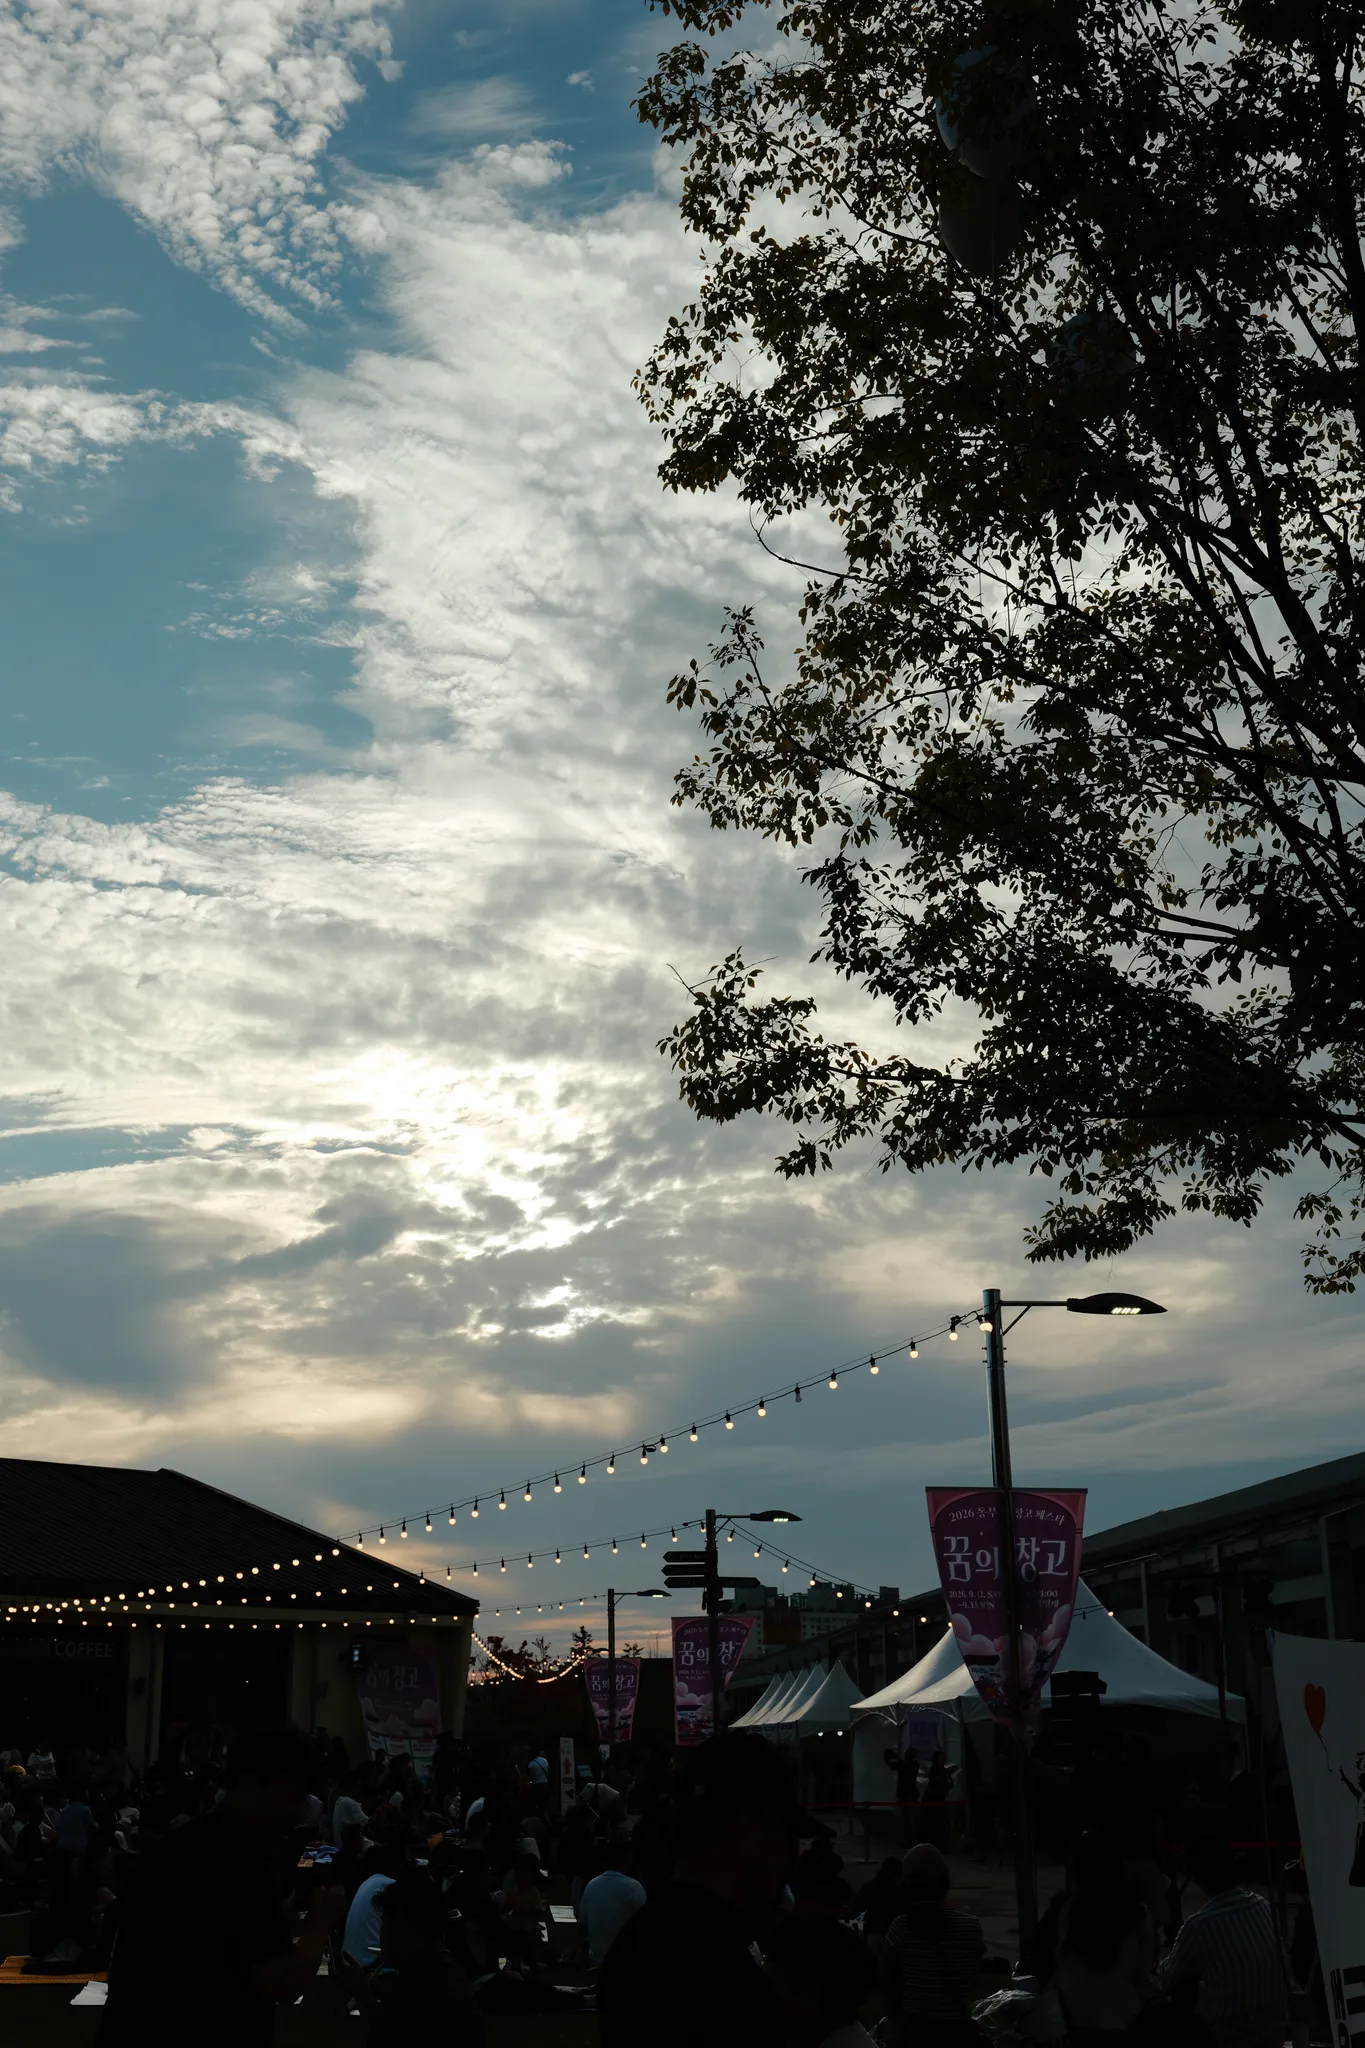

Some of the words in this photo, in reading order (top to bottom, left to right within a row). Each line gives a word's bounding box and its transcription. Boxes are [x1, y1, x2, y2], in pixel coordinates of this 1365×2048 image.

[949, 1507, 975, 1523] 2026
[1036, 1509, 1065, 1526] 페스타
[943, 1536, 999, 1582] 꿈의
[1014, 1536, 1069, 1582] 창고
[54, 1640, 116, 1658] COFFEE
[678, 1641, 709, 1666] 꿈의
[391, 1663, 422, 1692] 창고
[613, 1674, 636, 1692] 창고
